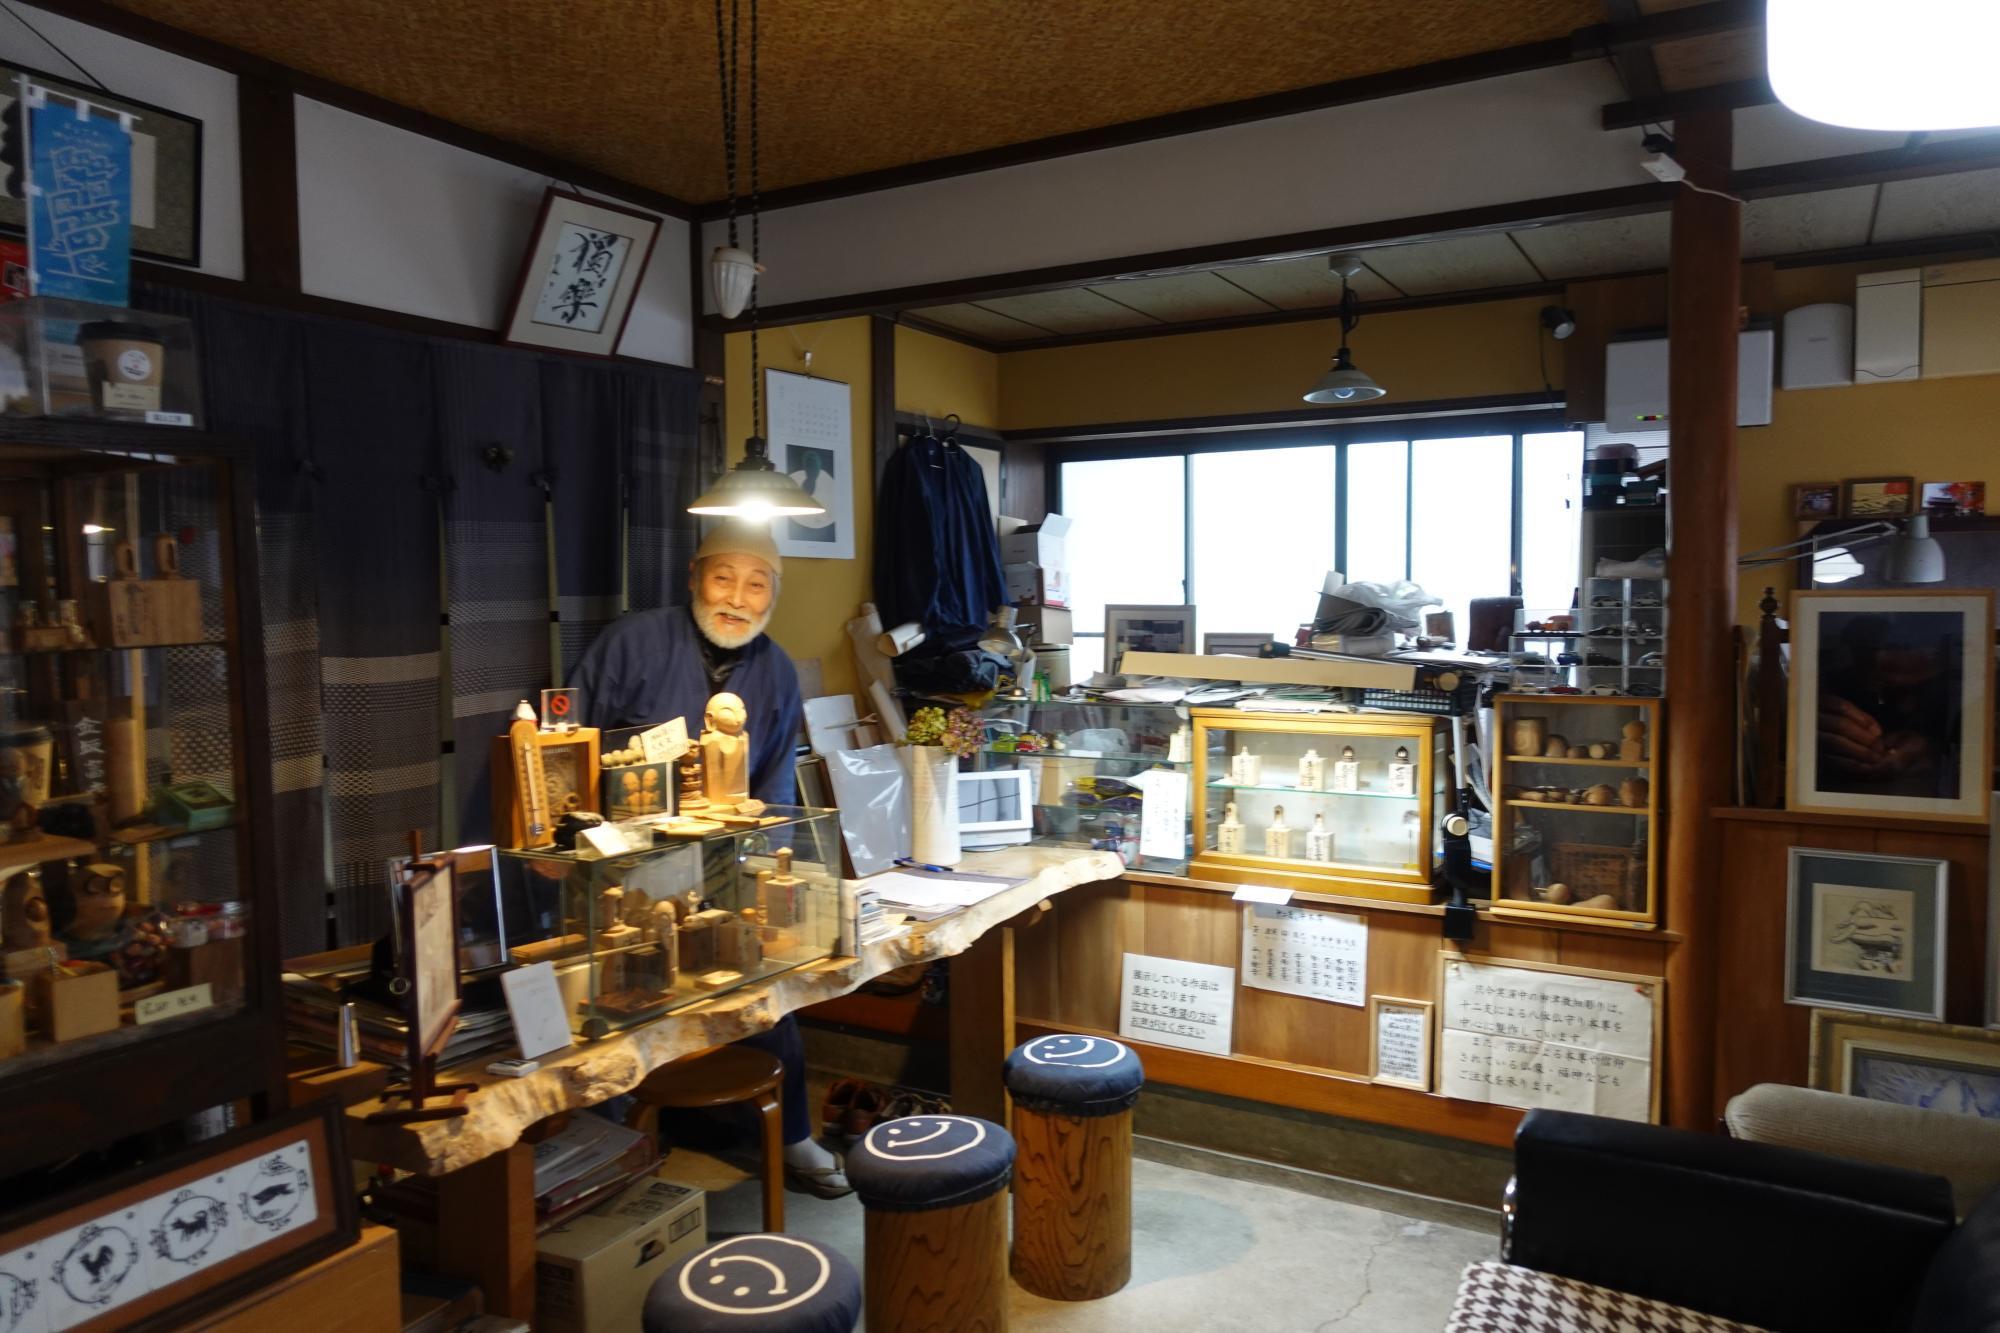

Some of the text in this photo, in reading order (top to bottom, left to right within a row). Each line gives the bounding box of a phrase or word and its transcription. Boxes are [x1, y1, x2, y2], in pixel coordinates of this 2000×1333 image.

[1132, 969, 1219, 991] 展示している作品は
[1131, 985, 1198, 1004] 見本となります
[1131, 1000, 1218, 1024] 注文をご希望の方は
